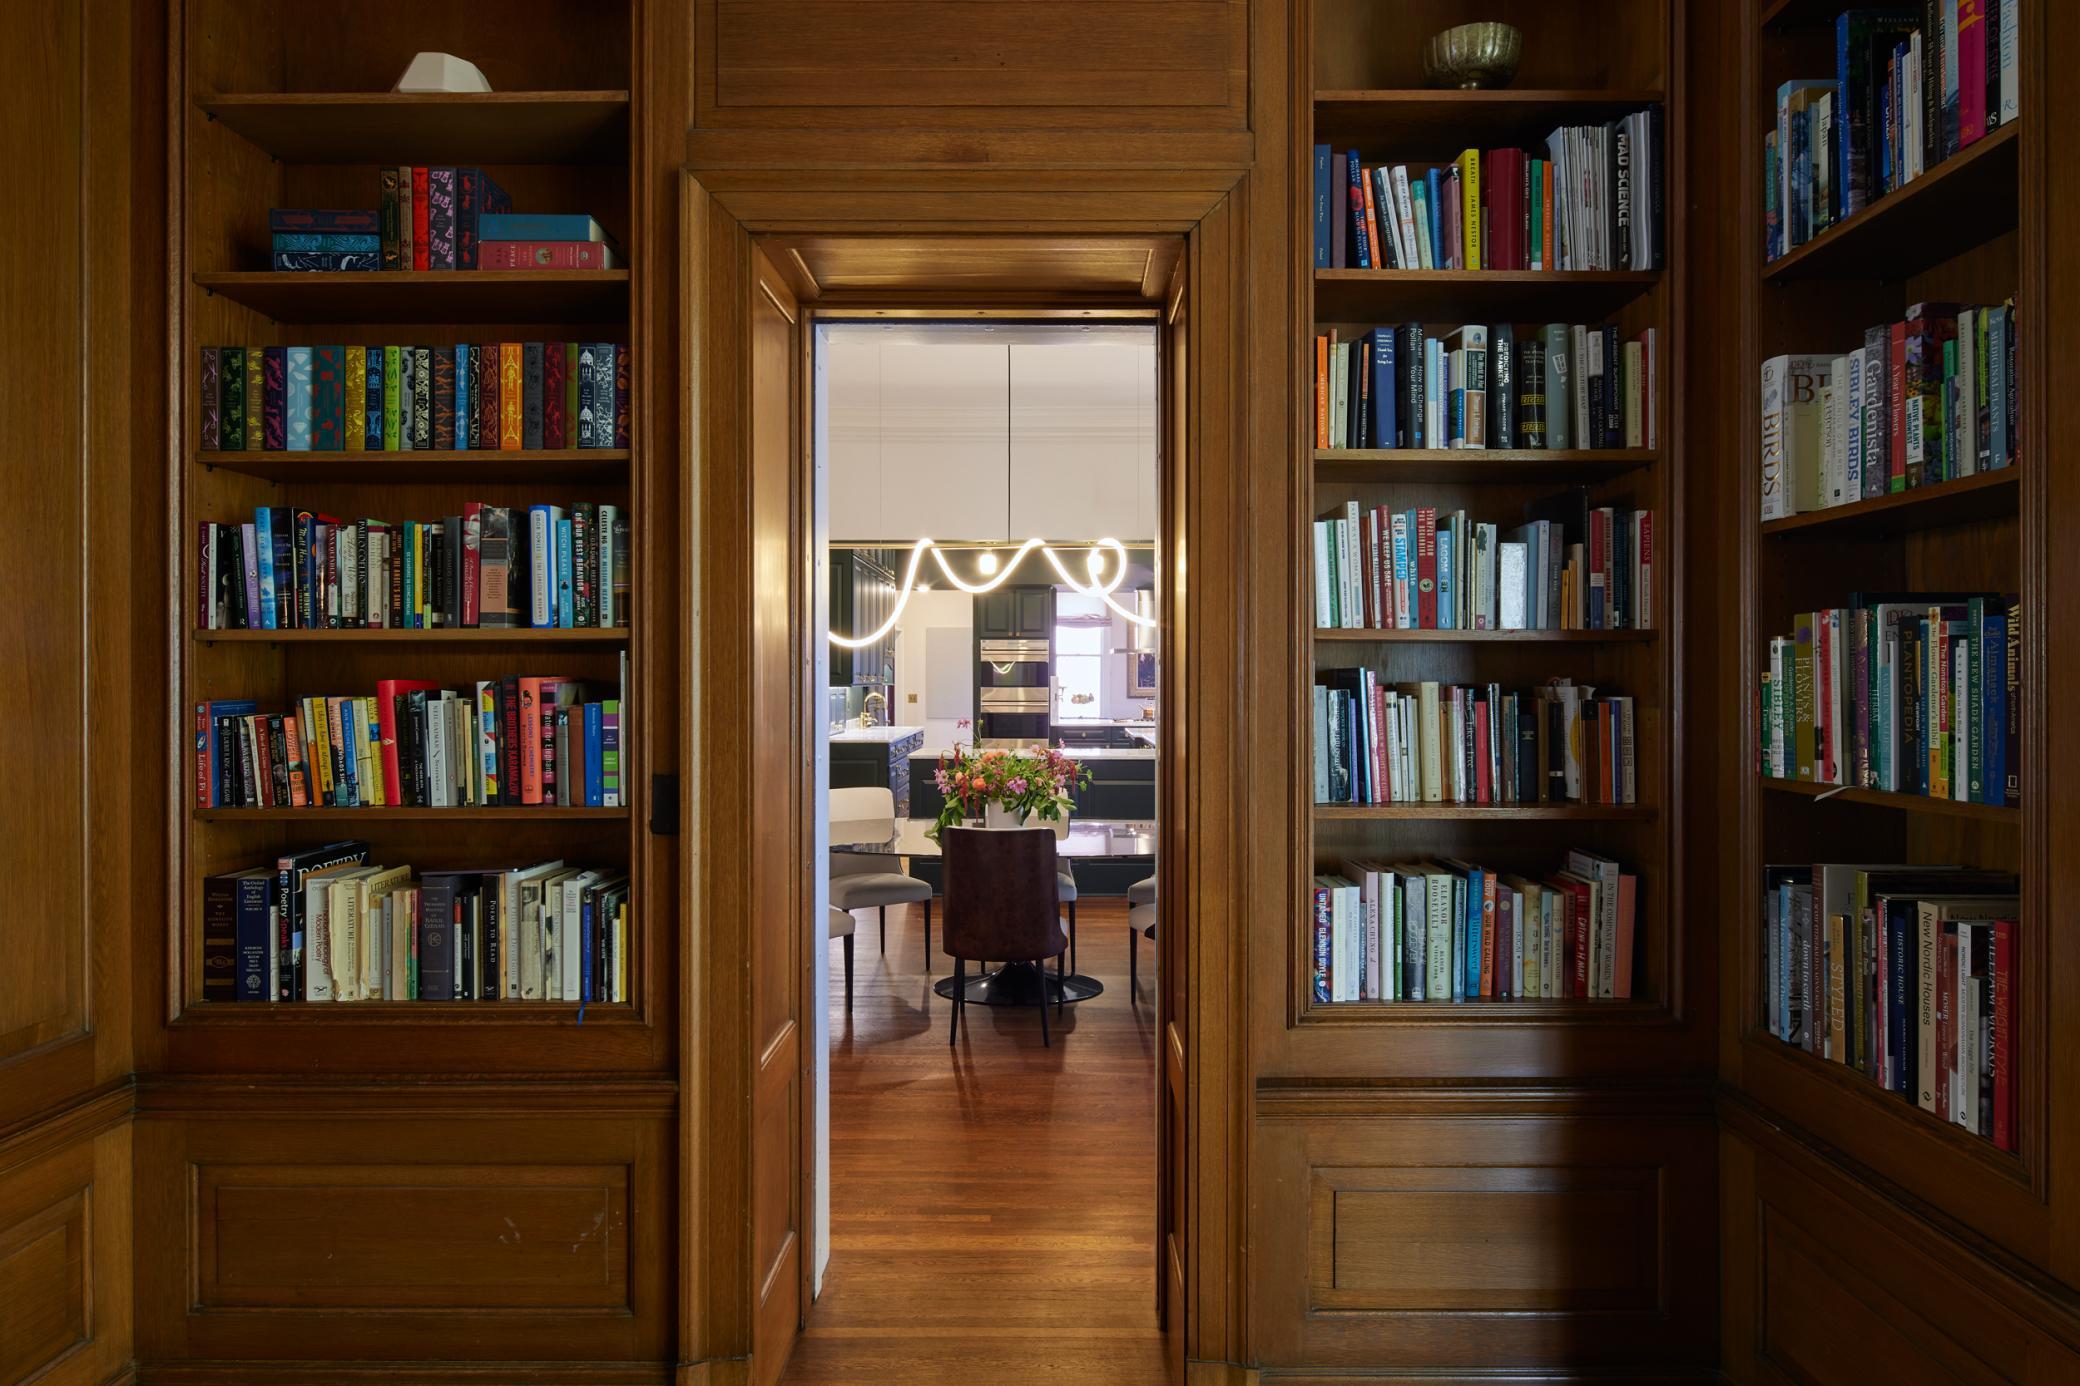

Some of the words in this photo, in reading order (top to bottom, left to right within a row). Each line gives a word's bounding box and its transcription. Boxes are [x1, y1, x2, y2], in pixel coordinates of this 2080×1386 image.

[1820, 115, 1830, 147] Japan
[1617, 133, 1630, 166] MAD
[1617, 168, 1630, 228] SCIENCE
[1470, 220, 1478, 248] NESTOR
[1892, 364, 1900, 372] A
[1991, 330, 1999, 390] MEDICINAL
[1417, 384, 1424, 392] to
[1848, 358, 1860, 422] SIBLEY
[1892, 374, 1900, 392] Year
[1866, 359, 1882, 467] Gardenista
[1892, 403, 1901, 436] Flowers
[1991, 392, 2000, 433] PLANTS
[1912, 424, 1920, 450] PLANTS
[1763, 412, 1782, 498] BIRDS
[1848, 427, 1860, 482] BIRDS
[1382, 530, 1390, 540] WE
[1384, 560, 1391, 569] US
[1394, 538, 1407, 580] STAMPED
[1440, 537, 1448, 572] LAGOM
[1384, 570, 1392, 587] SAFE
[2006, 603, 2020, 636] Wild
[2006, 636, 2020, 692] Animals
[1795, 656, 1803, 723] FLOWERS
[1802, 656, 1811, 711] PLANTS
[1903, 630, 1914, 744] PLANTOPEDIA
[544, 710, 554, 730] Water
[1773, 680, 1781, 730] SIBLEY
[544, 732, 554, 742] for
[198, 754, 206, 770] Life
[544, 744, 554, 778] Elephants
[198, 782, 206, 792] Pi
[1606, 883, 1613, 891] IN
[1606, 893, 1614, 907] THE
[1318, 893, 1327, 922] UNTAMED
[1440, 884, 1448, 925] ELEANOR
[1605, 908, 1614, 942] COMPANY
[1922, 912, 1932, 938] New
[1472, 918, 1480, 970] Bittersweet
[1605, 943, 1612, 952] OF
[1802, 940, 1811, 968] down
[1896, 932, 1904, 972] HISTORIC
[1318, 958, 1326, 978] DOYLE
[1577, 961, 1586, 982] MART
[1604, 954, 1612, 980] WOMEN
[1922, 940, 1932, 981] Nordic
[1802, 972, 1810, 982] to
[1896, 976, 1904, 1006] HOUSE
[1802, 982, 1811, 1012] earth
[1831, 962, 1844, 1032] STYLED
[1922, 982, 1932, 1026] Houses
